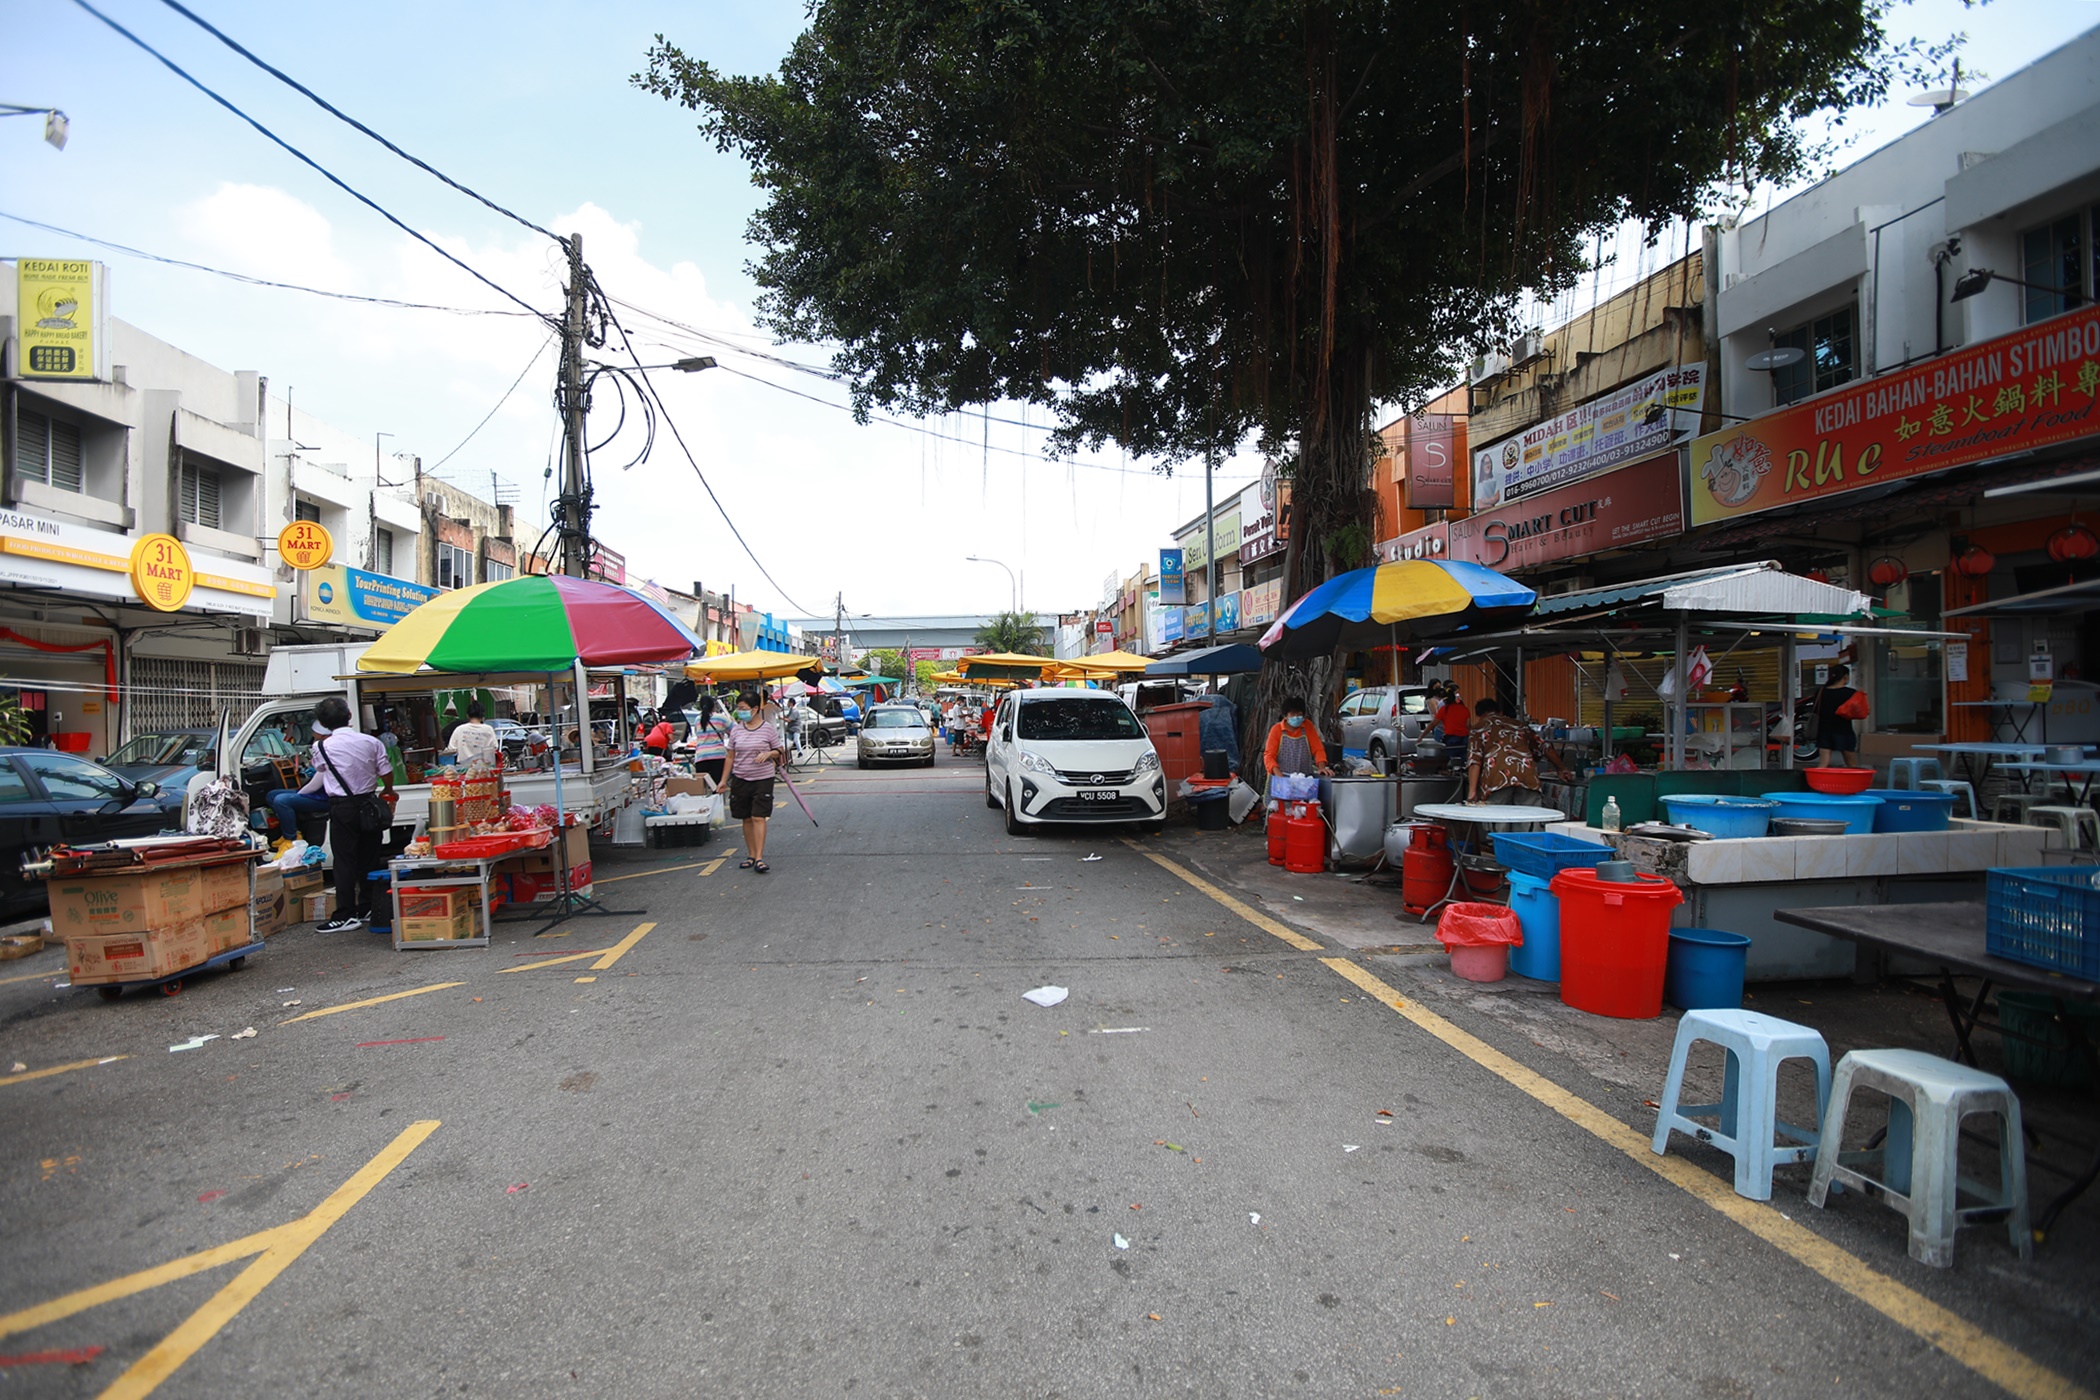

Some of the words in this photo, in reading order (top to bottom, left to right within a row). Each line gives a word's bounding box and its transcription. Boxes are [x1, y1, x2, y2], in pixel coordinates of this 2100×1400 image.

[24, 261, 59, 272] KEDAI
[63, 263, 88, 273] ROTI
[24, 329, 40, 338] HAPPY
[56, 331, 71, 339] BREAD
[71, 331, 88, 340] BAKERY
[1815, 400, 1862, 435] KEDAI
[1866, 351, 2002, 416] BAHAN-BAHAN
[1417, 421, 1447, 431] SALUN
[1523, 419, 1563, 447] MIDAH
[1905, 413, 2028, 463] Steamboat
[2030, 397, 2097, 432] Food
[1732, 432, 1773, 476] 如意
[1558, 501, 1598, 526] CUT
[1621, 524, 1630, 532] THE
[1632, 520, 1649, 530] SMART
[1650, 516, 1661, 526] CUT
[1662, 512, 1680, 523] BEGIN
[37, 520, 60, 536] MINI
[296, 527, 313, 540] 31
[1453, 521, 1481, 543] SALUN
[287, 540, 321, 550] MART
[1188, 544, 1202, 564] Seri
[1202, 529, 1236, 557] Uform
[1390, 535, 1444, 562] Studio
[1511, 538, 1533, 554] Hair
[1540, 536, 1548, 546] &
[1554, 526, 1595, 544] Beauty
[29, 544, 65, 556] PRODUCTS
[65, 549, 103, 563] WHOLESALE
[156, 543, 173, 564] 31
[146, 562, 183, 581] MART
[402, 586, 428, 604] Solution
[1080, 792, 1095, 801] VCU
[1096, 791, 1117, 800] 5508
[84, 889, 118, 905] Olive
